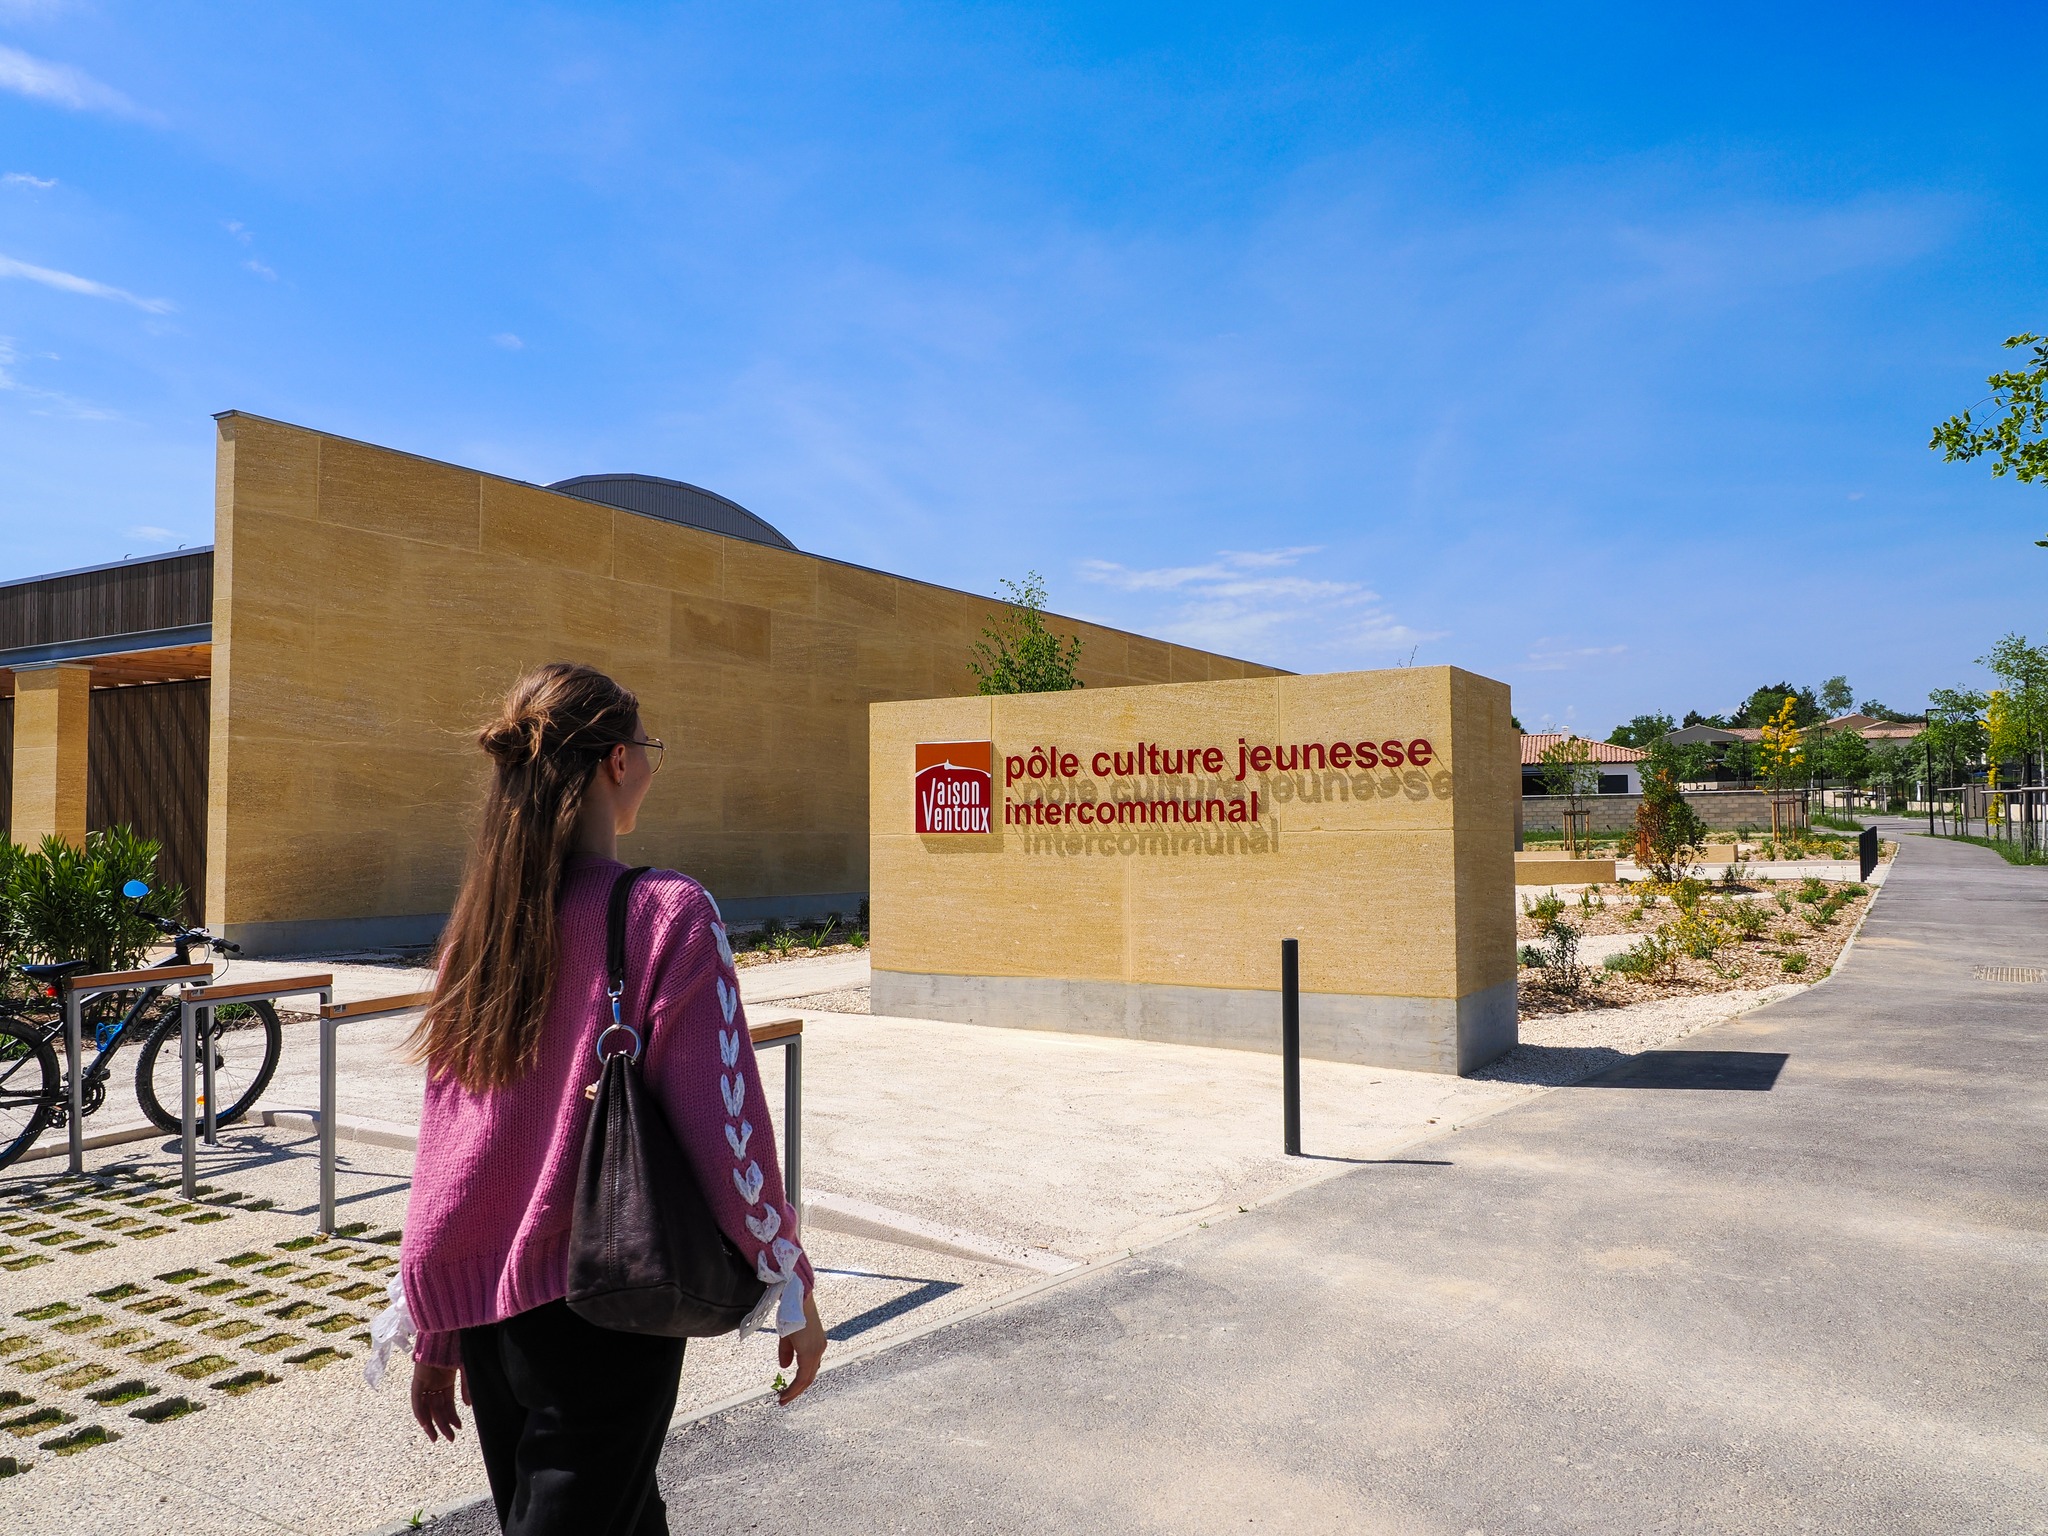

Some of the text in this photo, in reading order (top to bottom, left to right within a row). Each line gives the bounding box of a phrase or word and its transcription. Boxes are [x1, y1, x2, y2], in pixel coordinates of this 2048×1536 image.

[1005, 738, 1433, 788] pôle culture jeunesse
[922, 777, 980, 817] Vaison
[922, 798, 990, 833] Ventoux
[1005, 790, 1259, 825] intercommunal
